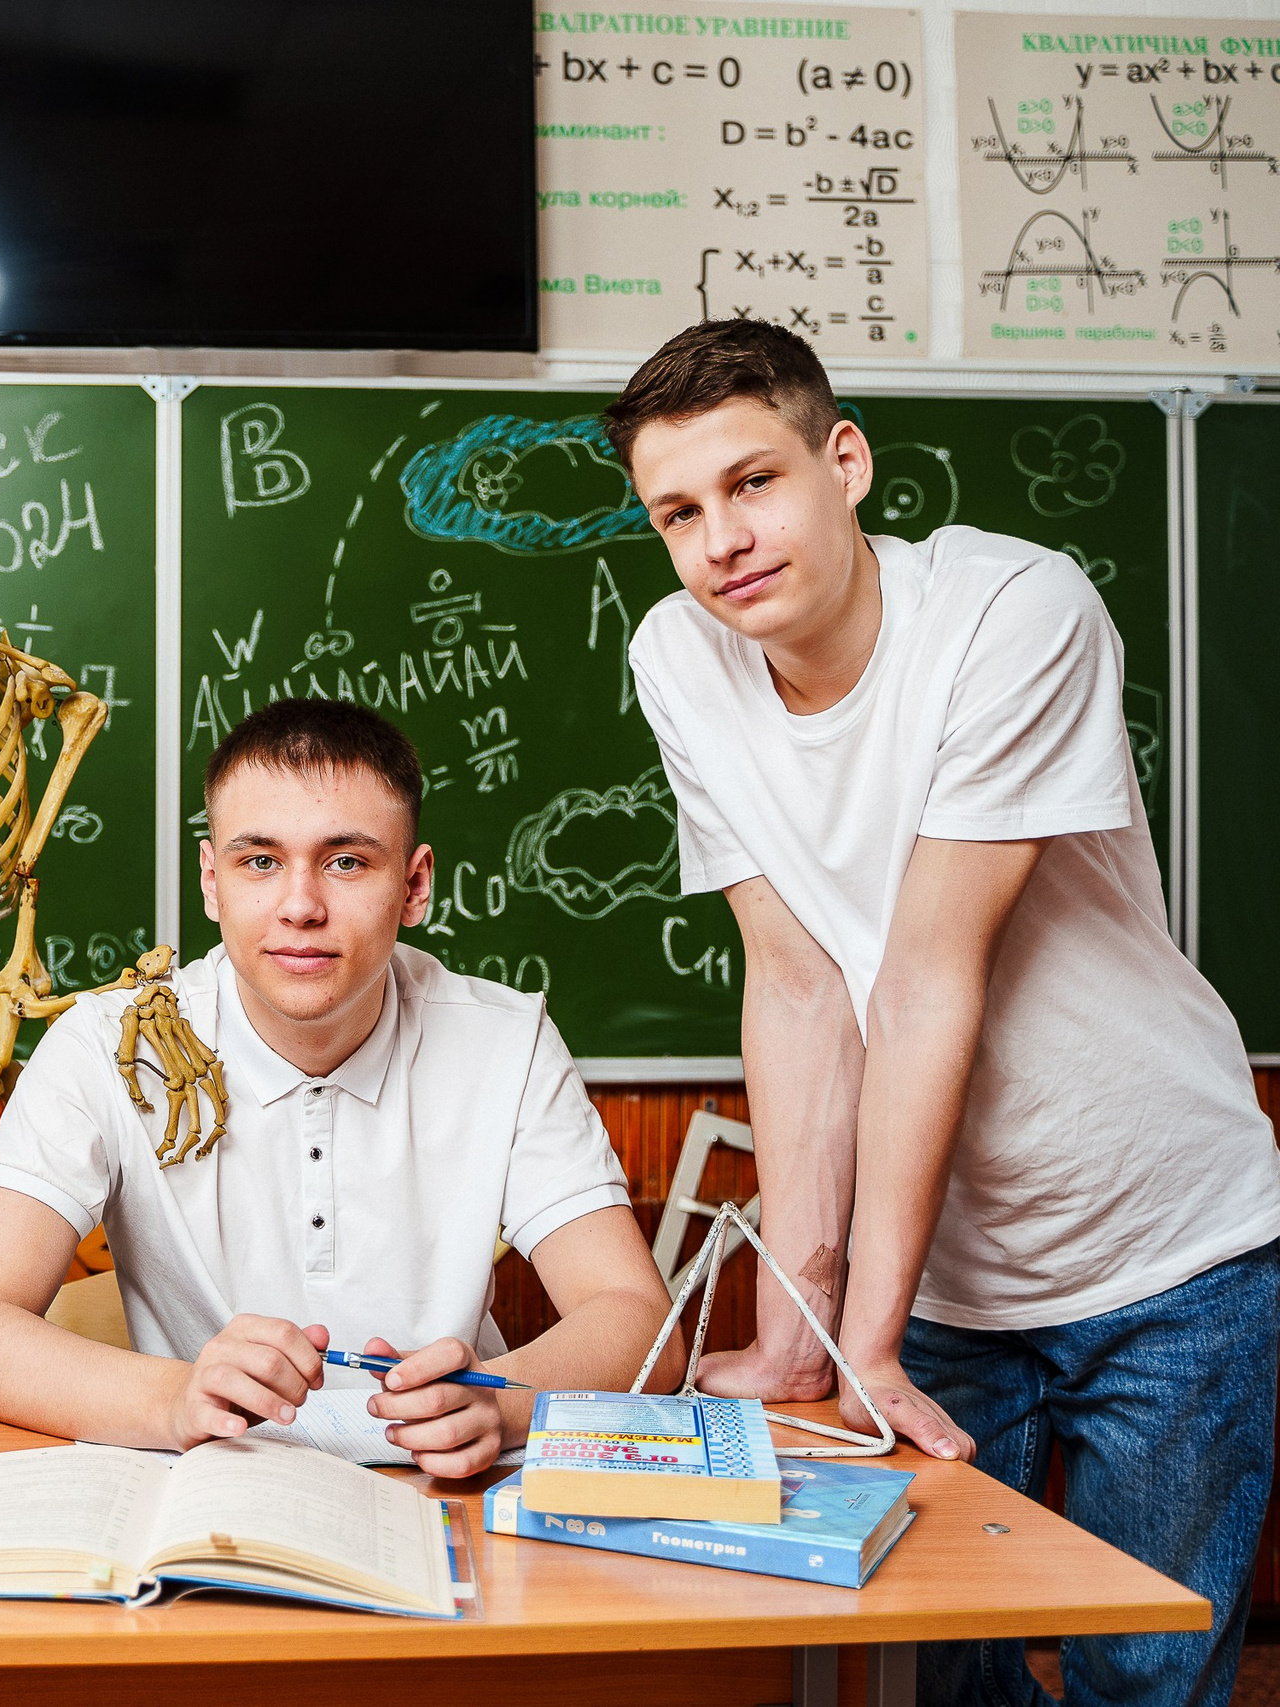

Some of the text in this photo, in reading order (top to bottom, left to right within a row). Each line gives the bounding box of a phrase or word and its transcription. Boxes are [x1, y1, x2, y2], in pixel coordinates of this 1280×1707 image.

[695, 17, 851, 40] УРАВНЕНИЕ
[1022, 32, 1209, 56] КВАДРАТИЧНАЯ
[583, 273, 662, 296] Виета
[541, 1443, 640, 1454] ЗАДАЧ
[547, 1431, 694, 1444] МАТЕМАТИКА
[541, 1449, 679, 1463] ОГЭ 3000
[651, 1531, 747, 1556] Геометрия
